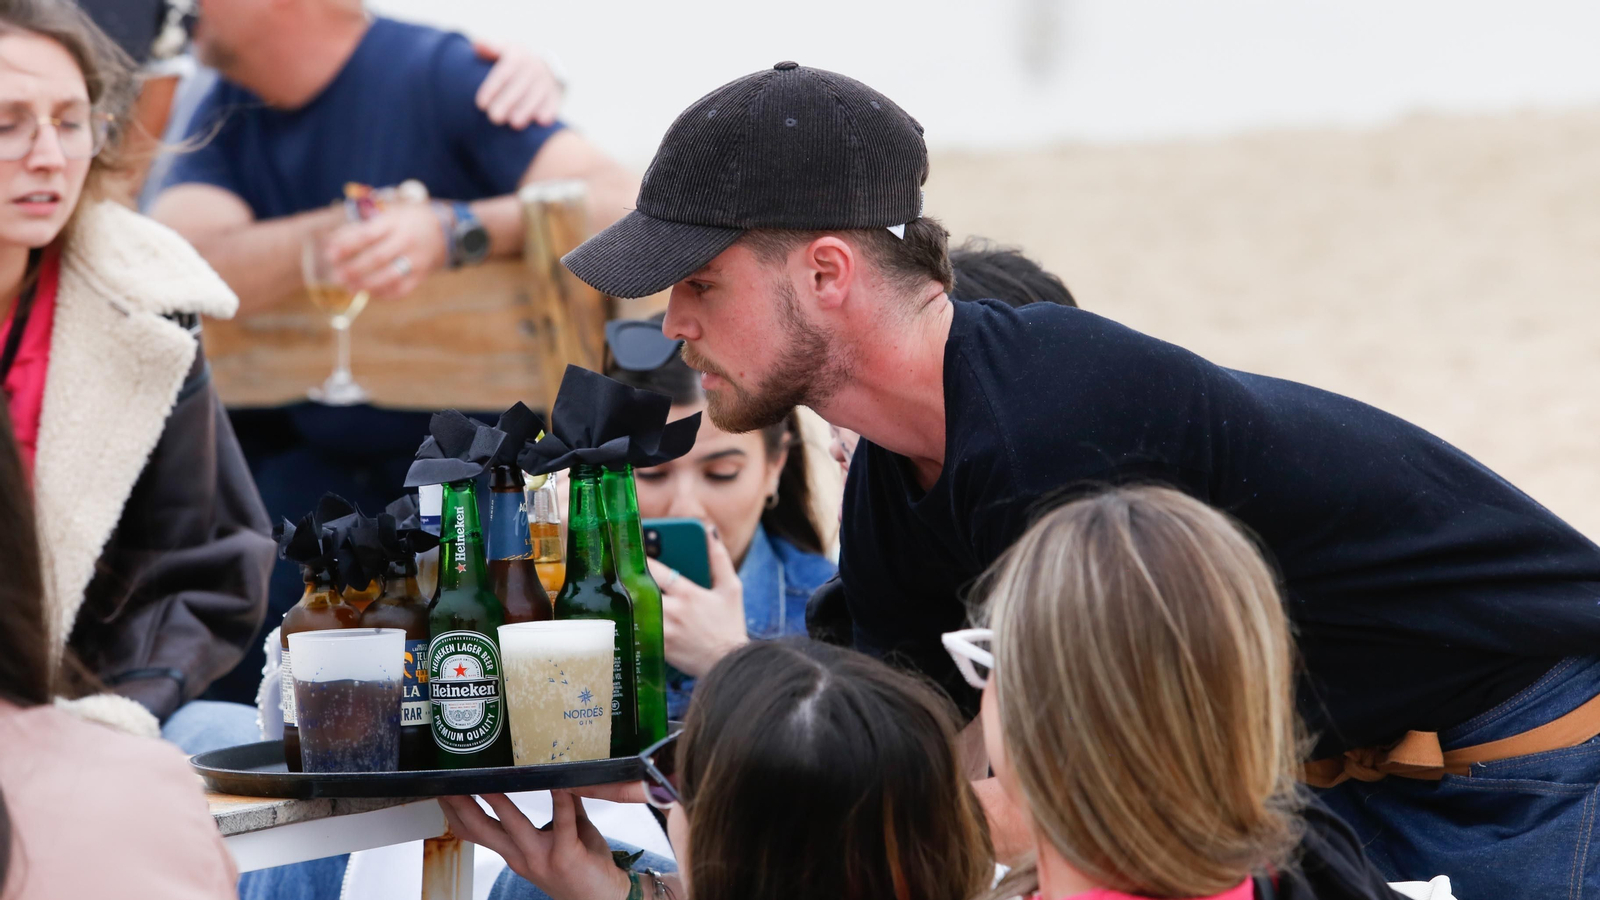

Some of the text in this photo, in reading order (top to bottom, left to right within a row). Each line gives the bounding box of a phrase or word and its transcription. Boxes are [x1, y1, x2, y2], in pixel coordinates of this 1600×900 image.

[455, 506, 465, 561] Heineken
[432, 643, 455, 672] HEINEKEN
[457, 642, 482, 656] LAGER
[480, 651, 494, 671] BEER
[432, 682, 495, 698] Heineken
[401, 707, 422, 721] RAR
[563, 705, 603, 720] NORDÉS
[434, 714, 464, 741] PREMIUM
[466, 712, 495, 741] QUALITY
